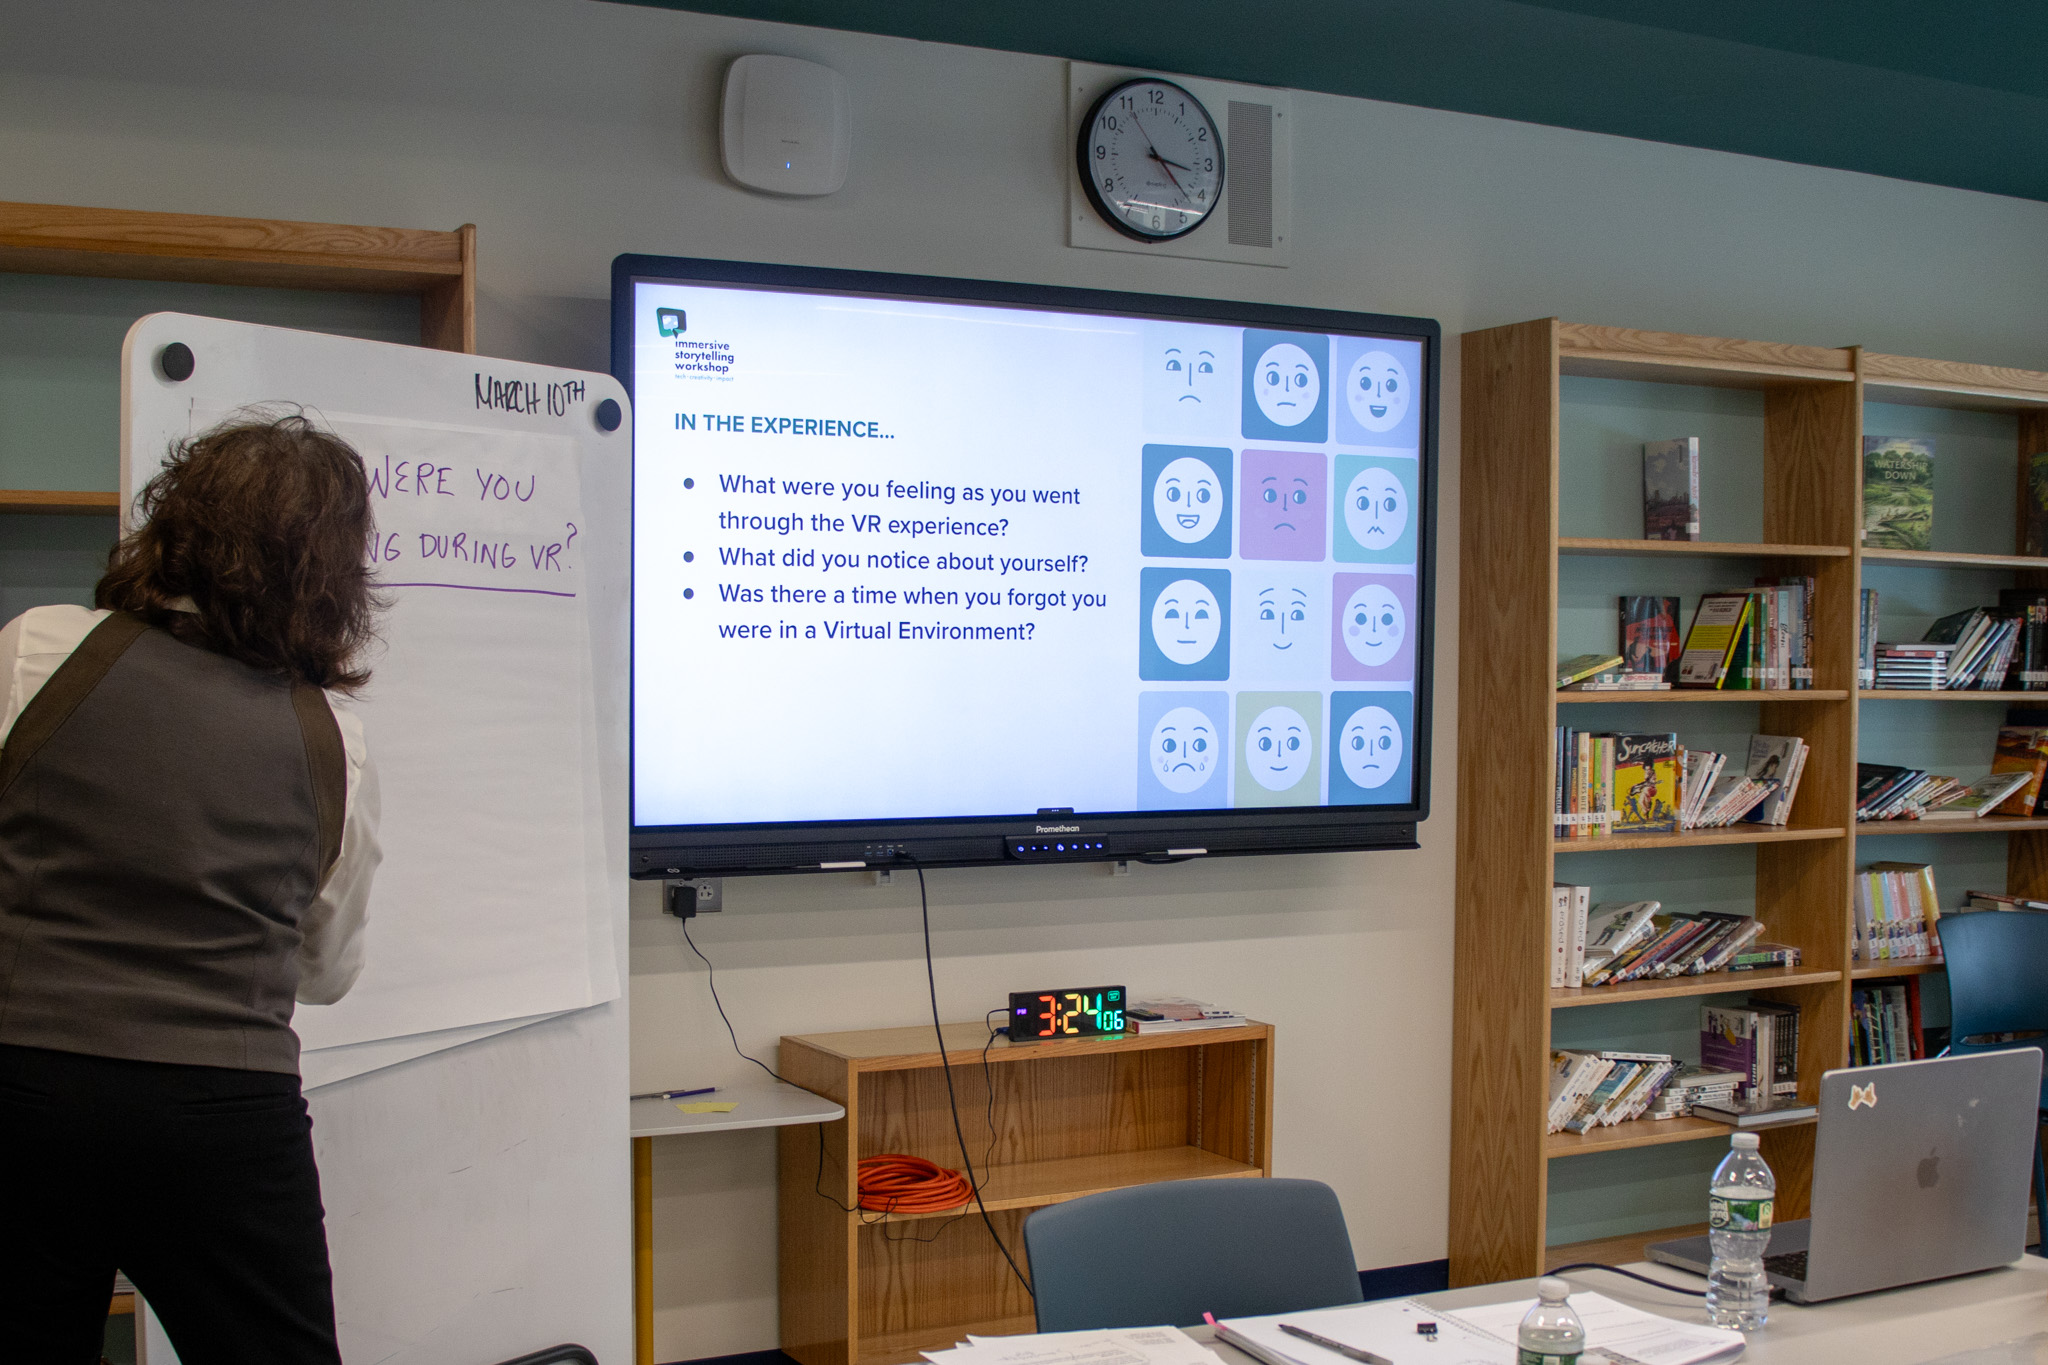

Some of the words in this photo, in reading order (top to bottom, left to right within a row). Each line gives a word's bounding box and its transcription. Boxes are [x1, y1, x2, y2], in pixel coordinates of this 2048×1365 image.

[1120, 96, 1133, 111] 11
[1148, 90, 1164, 105] 12
[1179, 103, 1185, 116] 1
[1102, 116, 1117, 130] 10
[1198, 128, 1207, 142] 2
[1096, 146, 1106, 160] 9
[1204, 158, 1213, 172] 3
[1104, 178, 1114, 192] 8
[1198, 189, 1206, 202] 4
[1124, 203, 1132, 217] 7
[1152, 215, 1161, 229] 6
[1179, 211, 1187, 224] 5
[675, 340, 730, 351] immersive
[675, 351, 734, 364] storytelling
[675, 362, 729, 375] workshop
[475, 373, 541, 414] MARCH
[548, 380, 585, 416] 10TH
[675, 413, 696, 431] IN
[703, 414, 744, 433] THE
[751, 416, 895, 439] EXPERIENCE...
[1874, 459, 1928, 471] WATERSHIP
[360, 455, 455, 499] WERE
[477, 468, 535, 502] YOU
[1885, 471, 1917, 480] DOWN
[719, 475, 776, 495] What
[782, 481, 835, 496] were
[842, 482, 879, 501] you
[886, 479, 956, 505] feeling
[962, 487, 984, 503] as
[991, 487, 1026, 507] you
[1033, 485, 1081, 505] went
[719, 512, 804, 536] through
[811, 513, 845, 533] the
[851, 515, 881, 533] VR
[888, 518, 1009, 539] experience?
[419, 532, 516, 569] DURING
[530, 522, 578, 572] VR?
[719, 548, 776, 568] What
[782, 549, 815, 569] did
[821, 554, 860, 574] you
[867, 552, 930, 571] notice
[936, 553, 994, 573] about
[1000, 554, 1089, 575] yourself?
[719, 584, 764, 604] Was
[770, 585, 827, 605] there
[834, 591, 845, 605] a
[852, 587, 896, 606] time
[903, 588, 959, 607] when
[965, 593, 1001, 611] you
[1007, 590, 1067, 611] forgot
[1072, 593, 1107, 613] you
[719, 623, 772, 639] were
[779, 620, 798, 639] in
[805, 625, 817, 639] a
[824, 621, 891, 640] Virtual
[899, 622, 1036, 641] Environment?
[1036, 825, 1080, 833] Promethean
[1016, 1008, 1027, 1016] PM
[1038, 993, 1102, 1036] 3:24
[1103, 1010, 1124, 1031] 06
